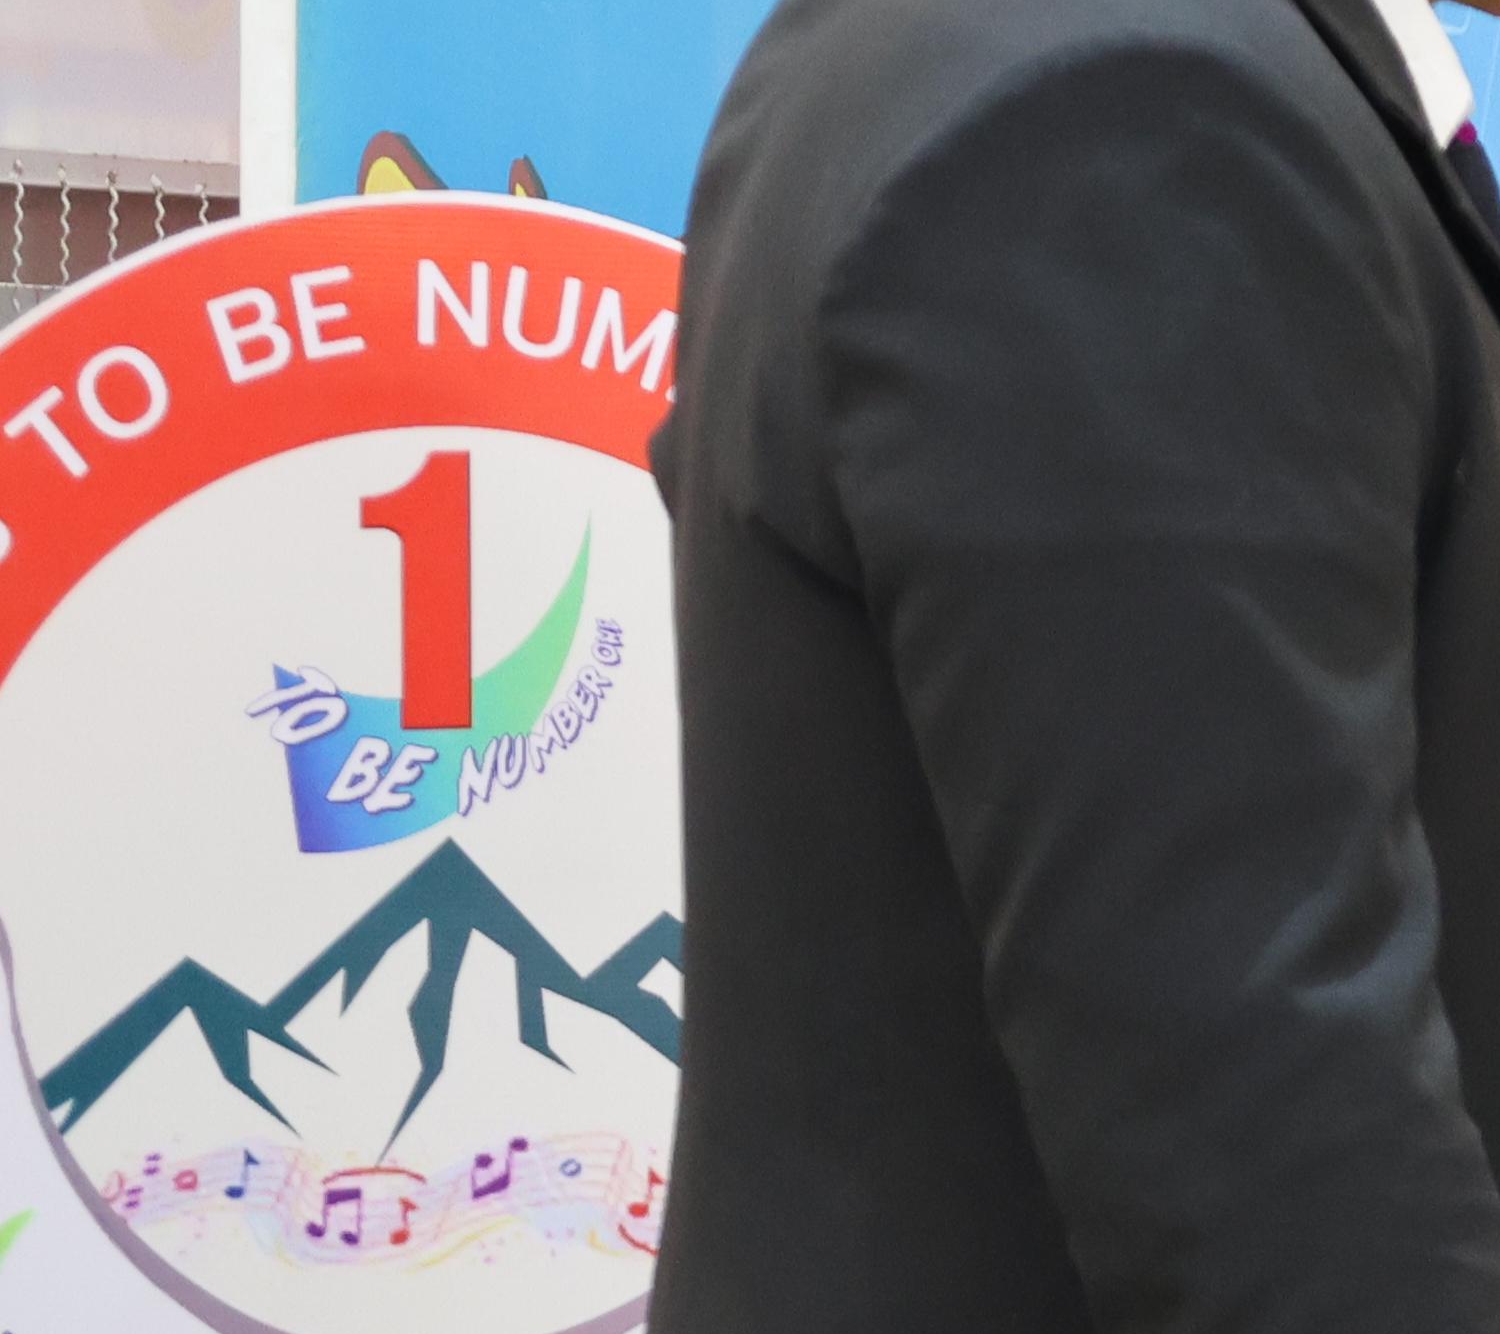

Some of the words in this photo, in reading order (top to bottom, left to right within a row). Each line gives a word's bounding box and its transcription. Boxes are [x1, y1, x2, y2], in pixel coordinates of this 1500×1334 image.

[4, 345, 170, 479] TO
[205, 265, 367, 384] BE
[416, 258, 678, 403] NUM
[244, 665, 350, 748] TO
[325, 736, 439, 815] BE
[456, 665, 615, 817] NUMBER
